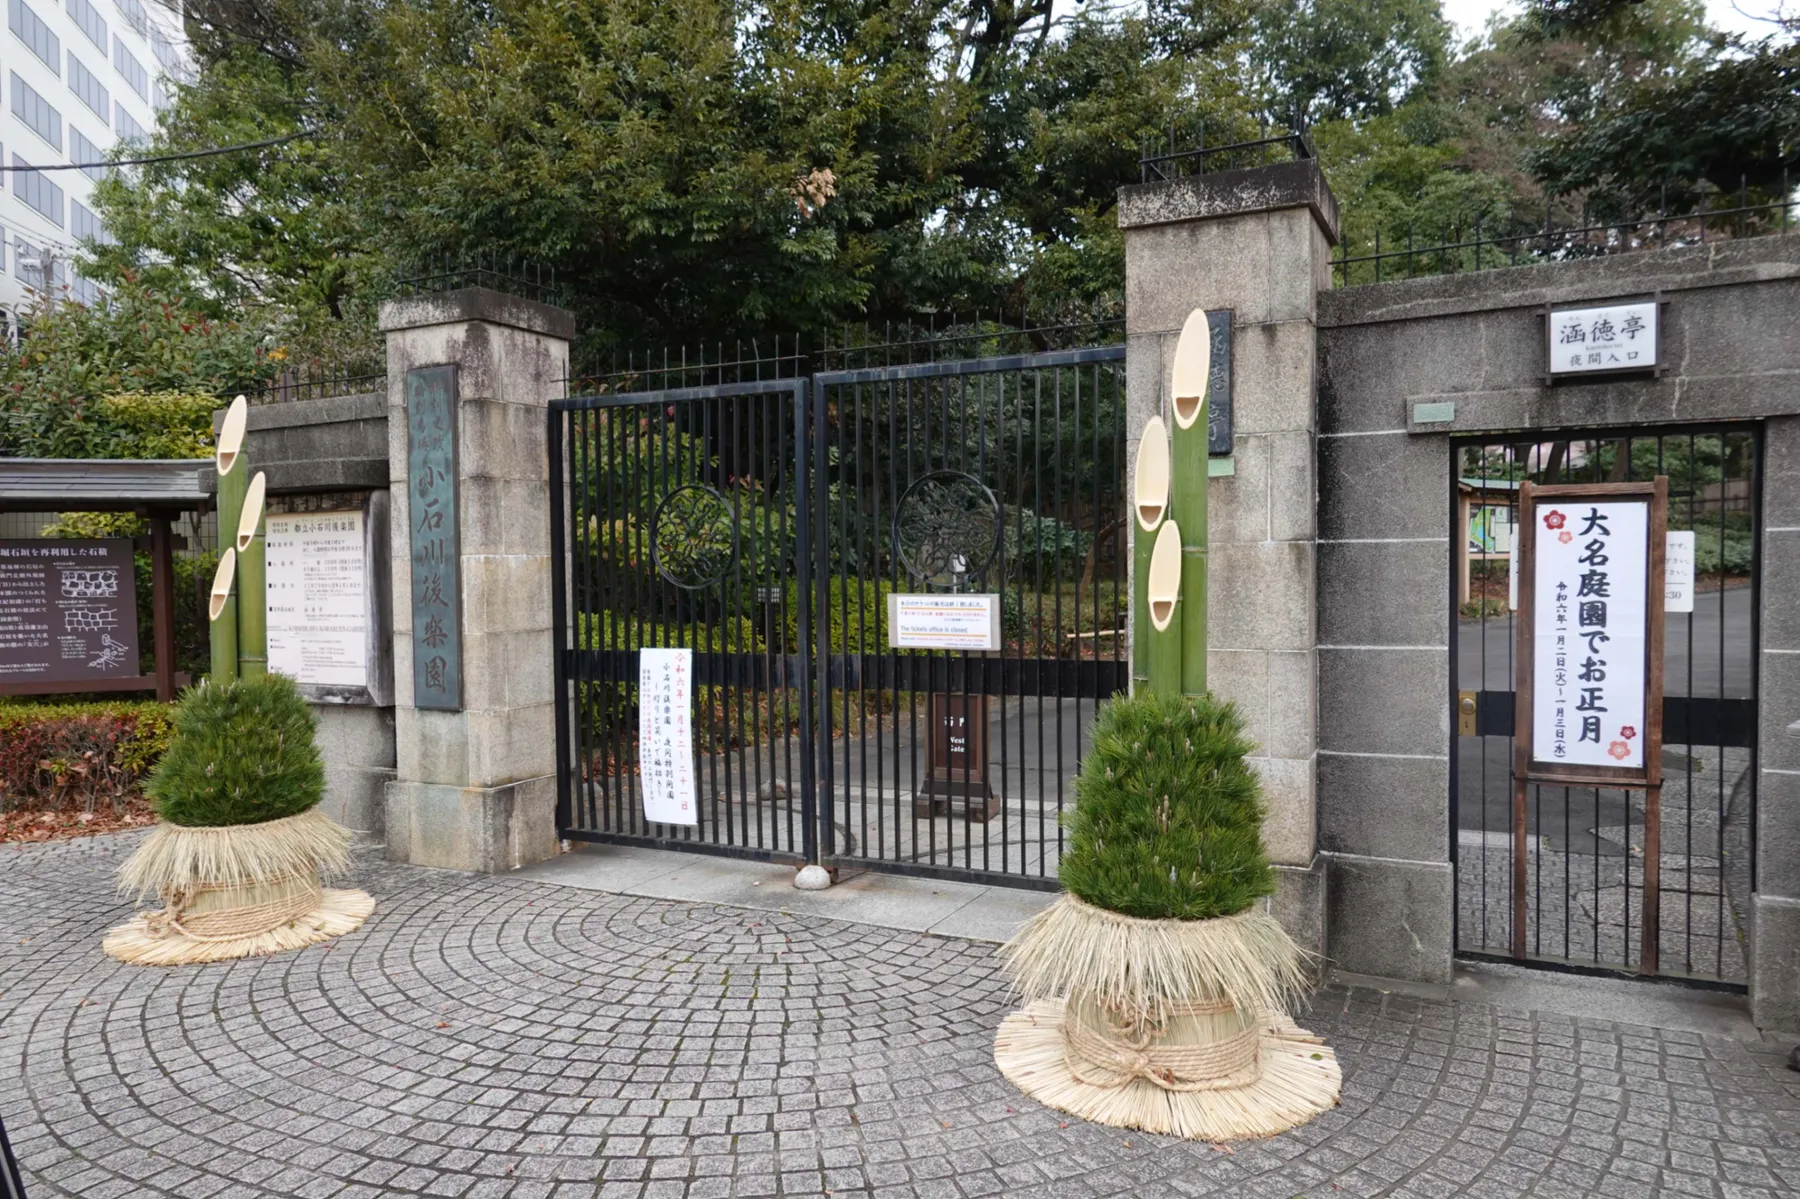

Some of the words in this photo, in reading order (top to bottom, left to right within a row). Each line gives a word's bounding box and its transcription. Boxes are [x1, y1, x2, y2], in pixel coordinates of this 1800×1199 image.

[1560, 315, 1646, 344] 涵徳亭
[1569, 351, 1639, 367] 夜間入口
[1575, 507, 1611, 744] 大名庭園でお正月
